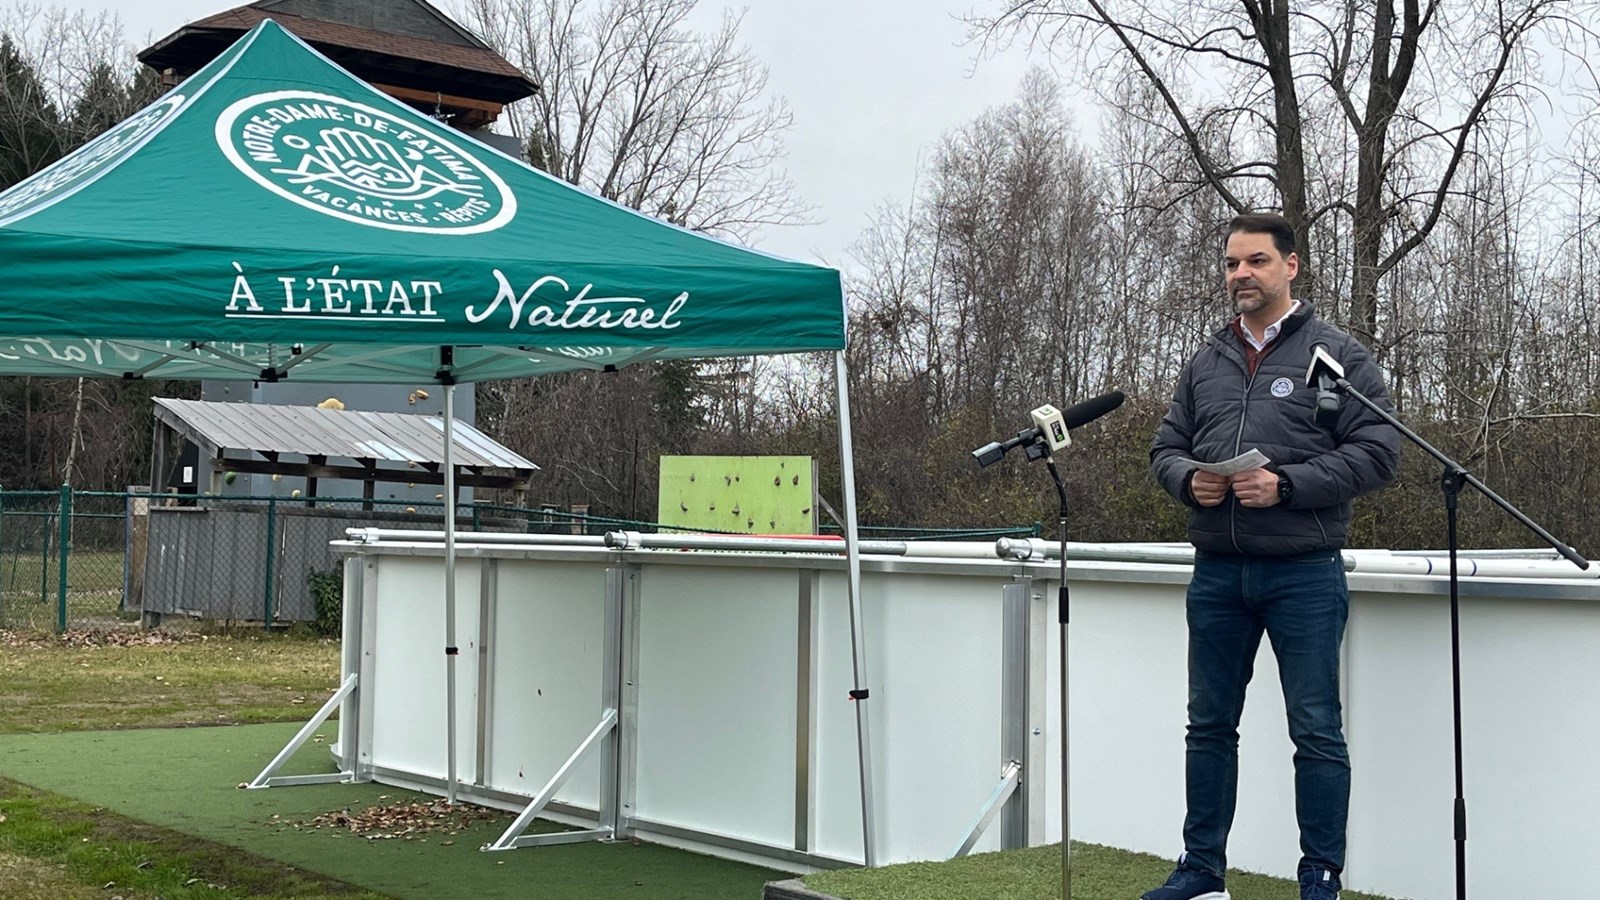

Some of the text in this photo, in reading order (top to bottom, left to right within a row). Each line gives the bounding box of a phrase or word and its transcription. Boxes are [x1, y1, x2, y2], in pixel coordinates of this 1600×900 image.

[242, 103, 481, 181] NOTRE-DAME-DE-FATIMA
[302, 184, 491, 224] VACANCES RÉPITS
[225, 261, 689, 331] À L'ÉTAT Naturel
